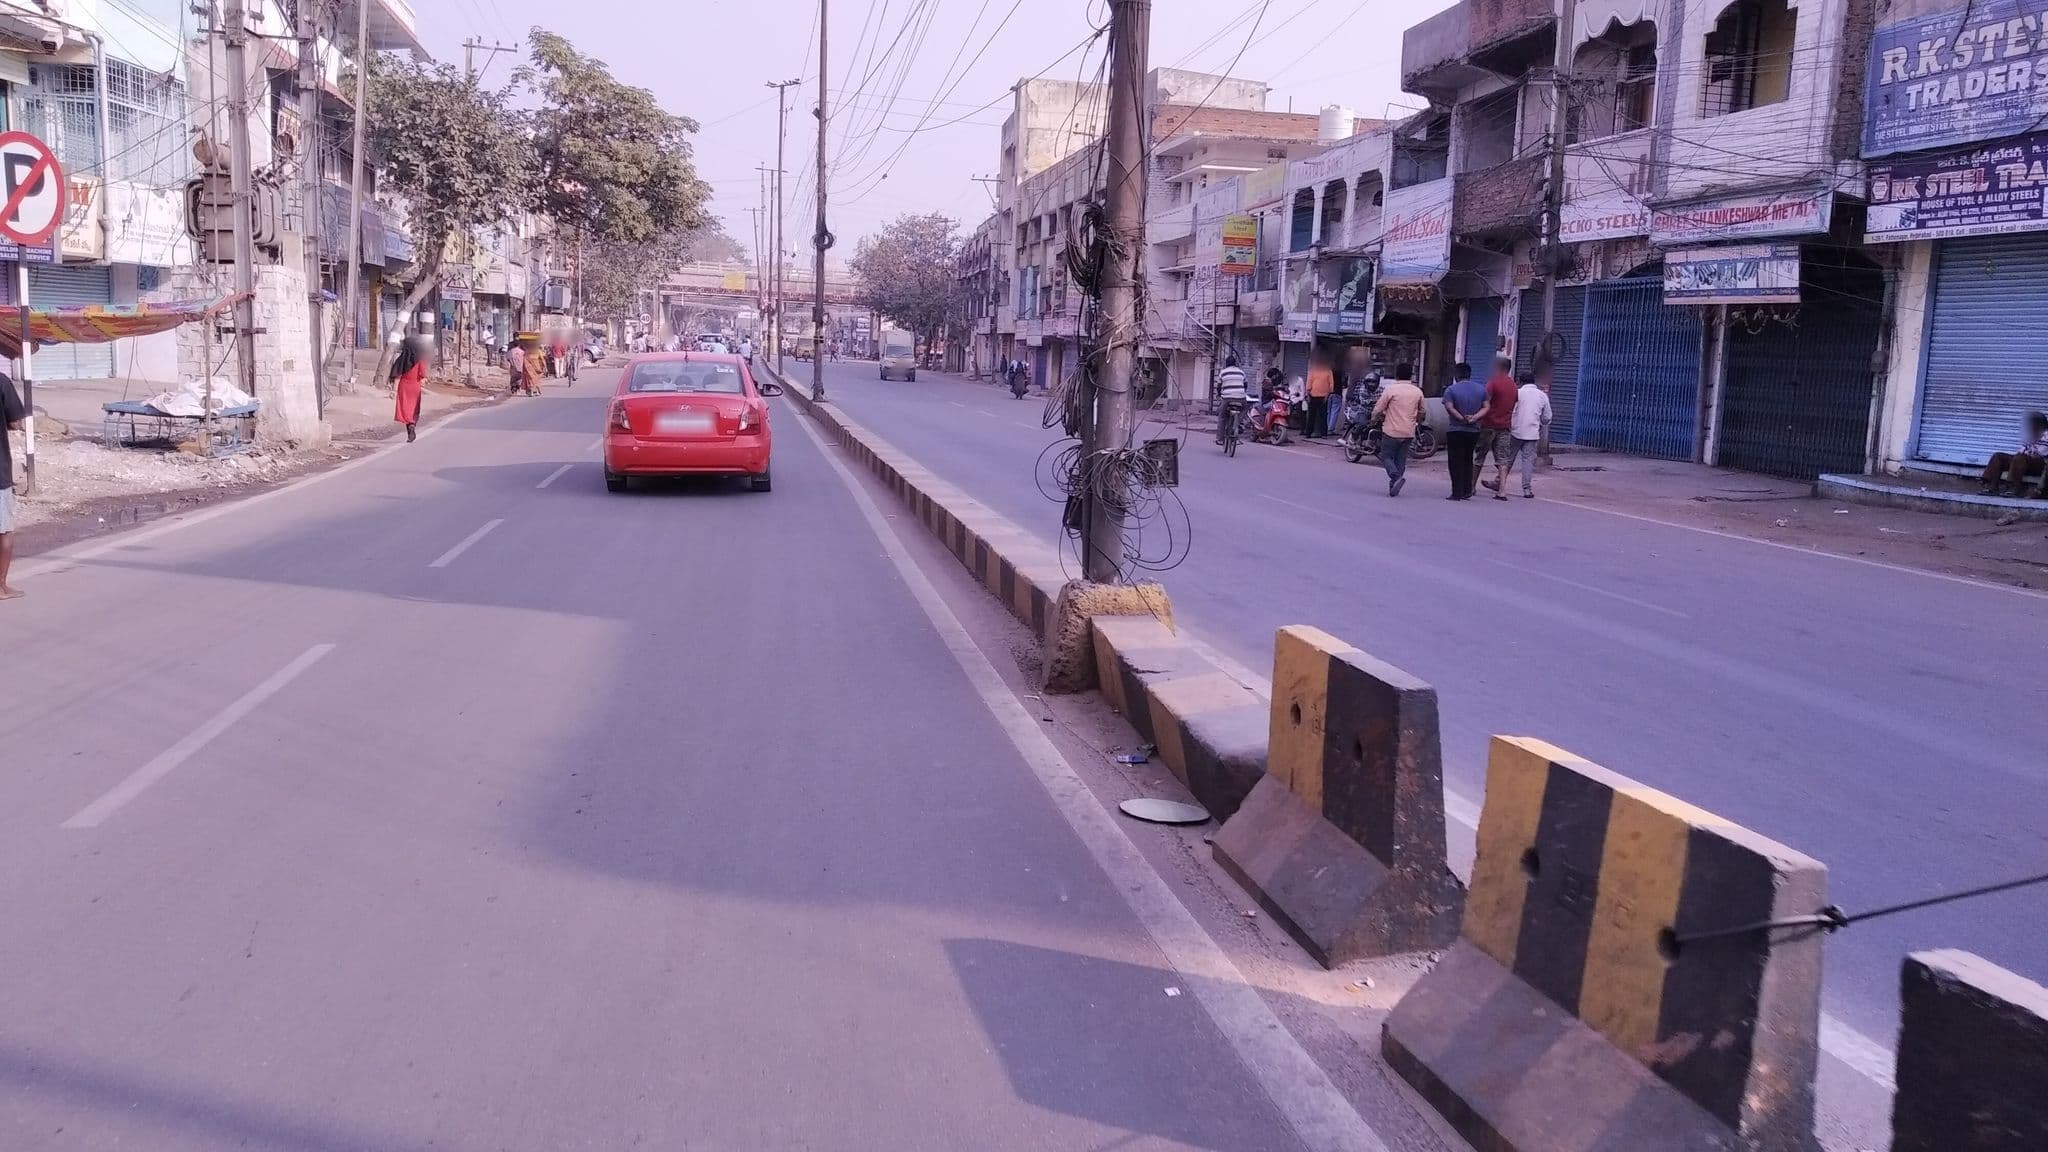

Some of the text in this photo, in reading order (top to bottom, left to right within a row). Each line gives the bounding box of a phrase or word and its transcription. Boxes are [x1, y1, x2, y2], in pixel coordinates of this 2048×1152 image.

[1891, 176, 1921, 201] RK
[1926, 168, 1990, 198] STEEL
[1921, 198, 1945, 209] HOUSE
[1945, 196, 1957, 207] OF
[1957, 195, 1976, 206] TOOL
[1985, 191, 2008, 203] ALLOY
[2010, 189, 2040, 200] STEELS
